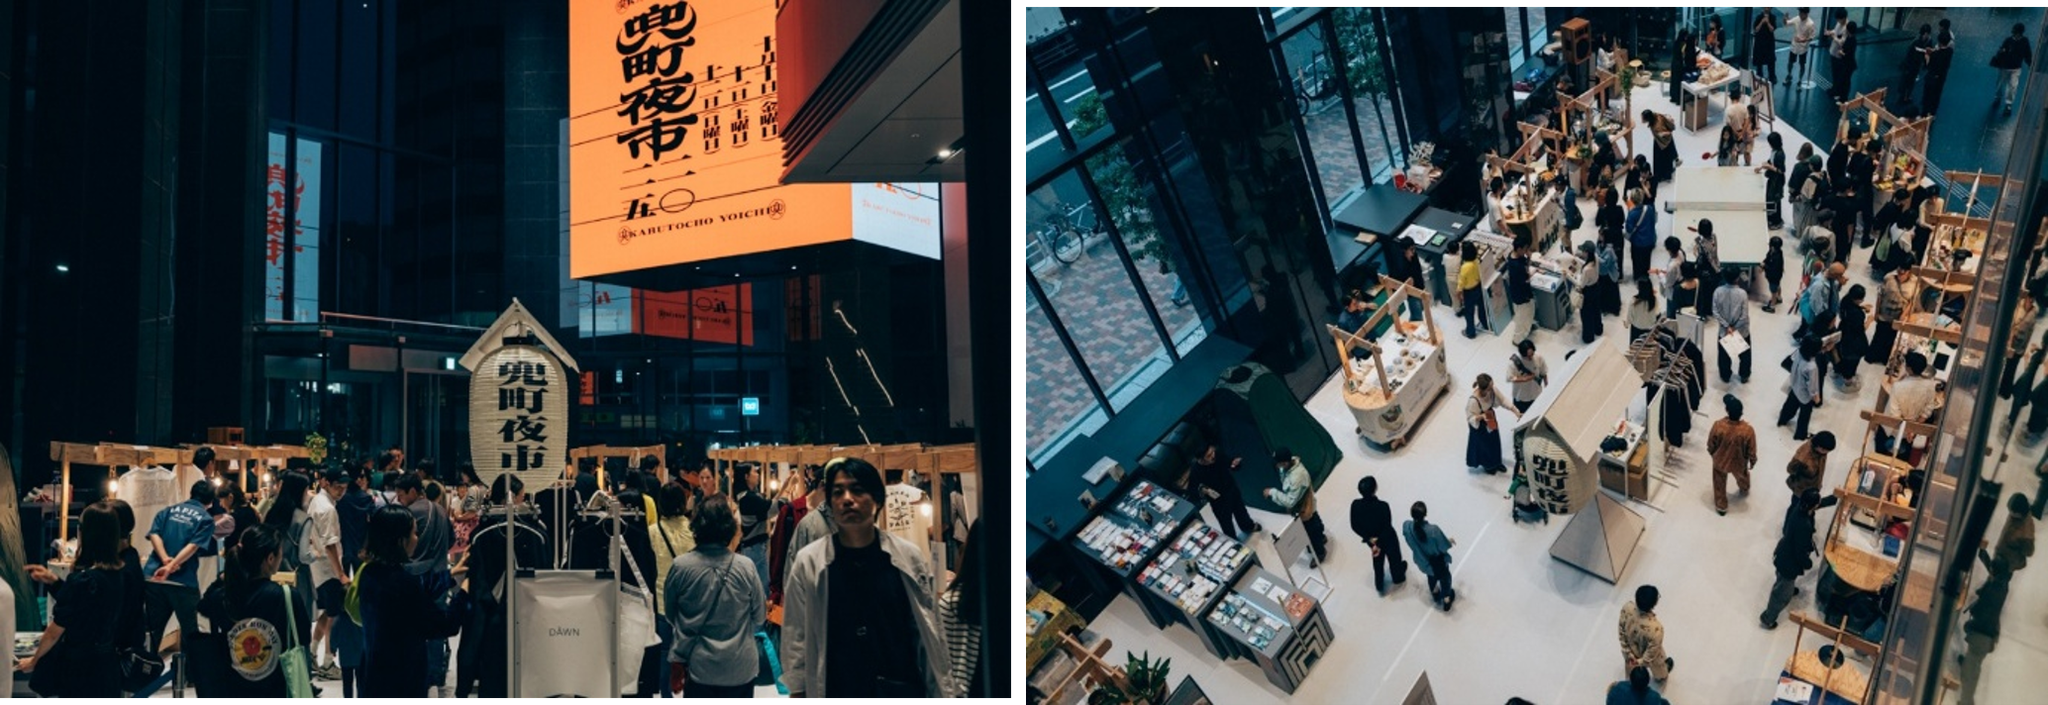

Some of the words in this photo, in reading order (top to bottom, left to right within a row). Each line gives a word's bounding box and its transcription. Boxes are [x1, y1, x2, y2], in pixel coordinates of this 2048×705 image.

[616, 1, 698, 161] 兜町夜市
[628, 217, 714, 239] KABUTOCHO
[719, 207, 771, 222] YOICHI
[498, 361, 549, 471] 兜町夜市
